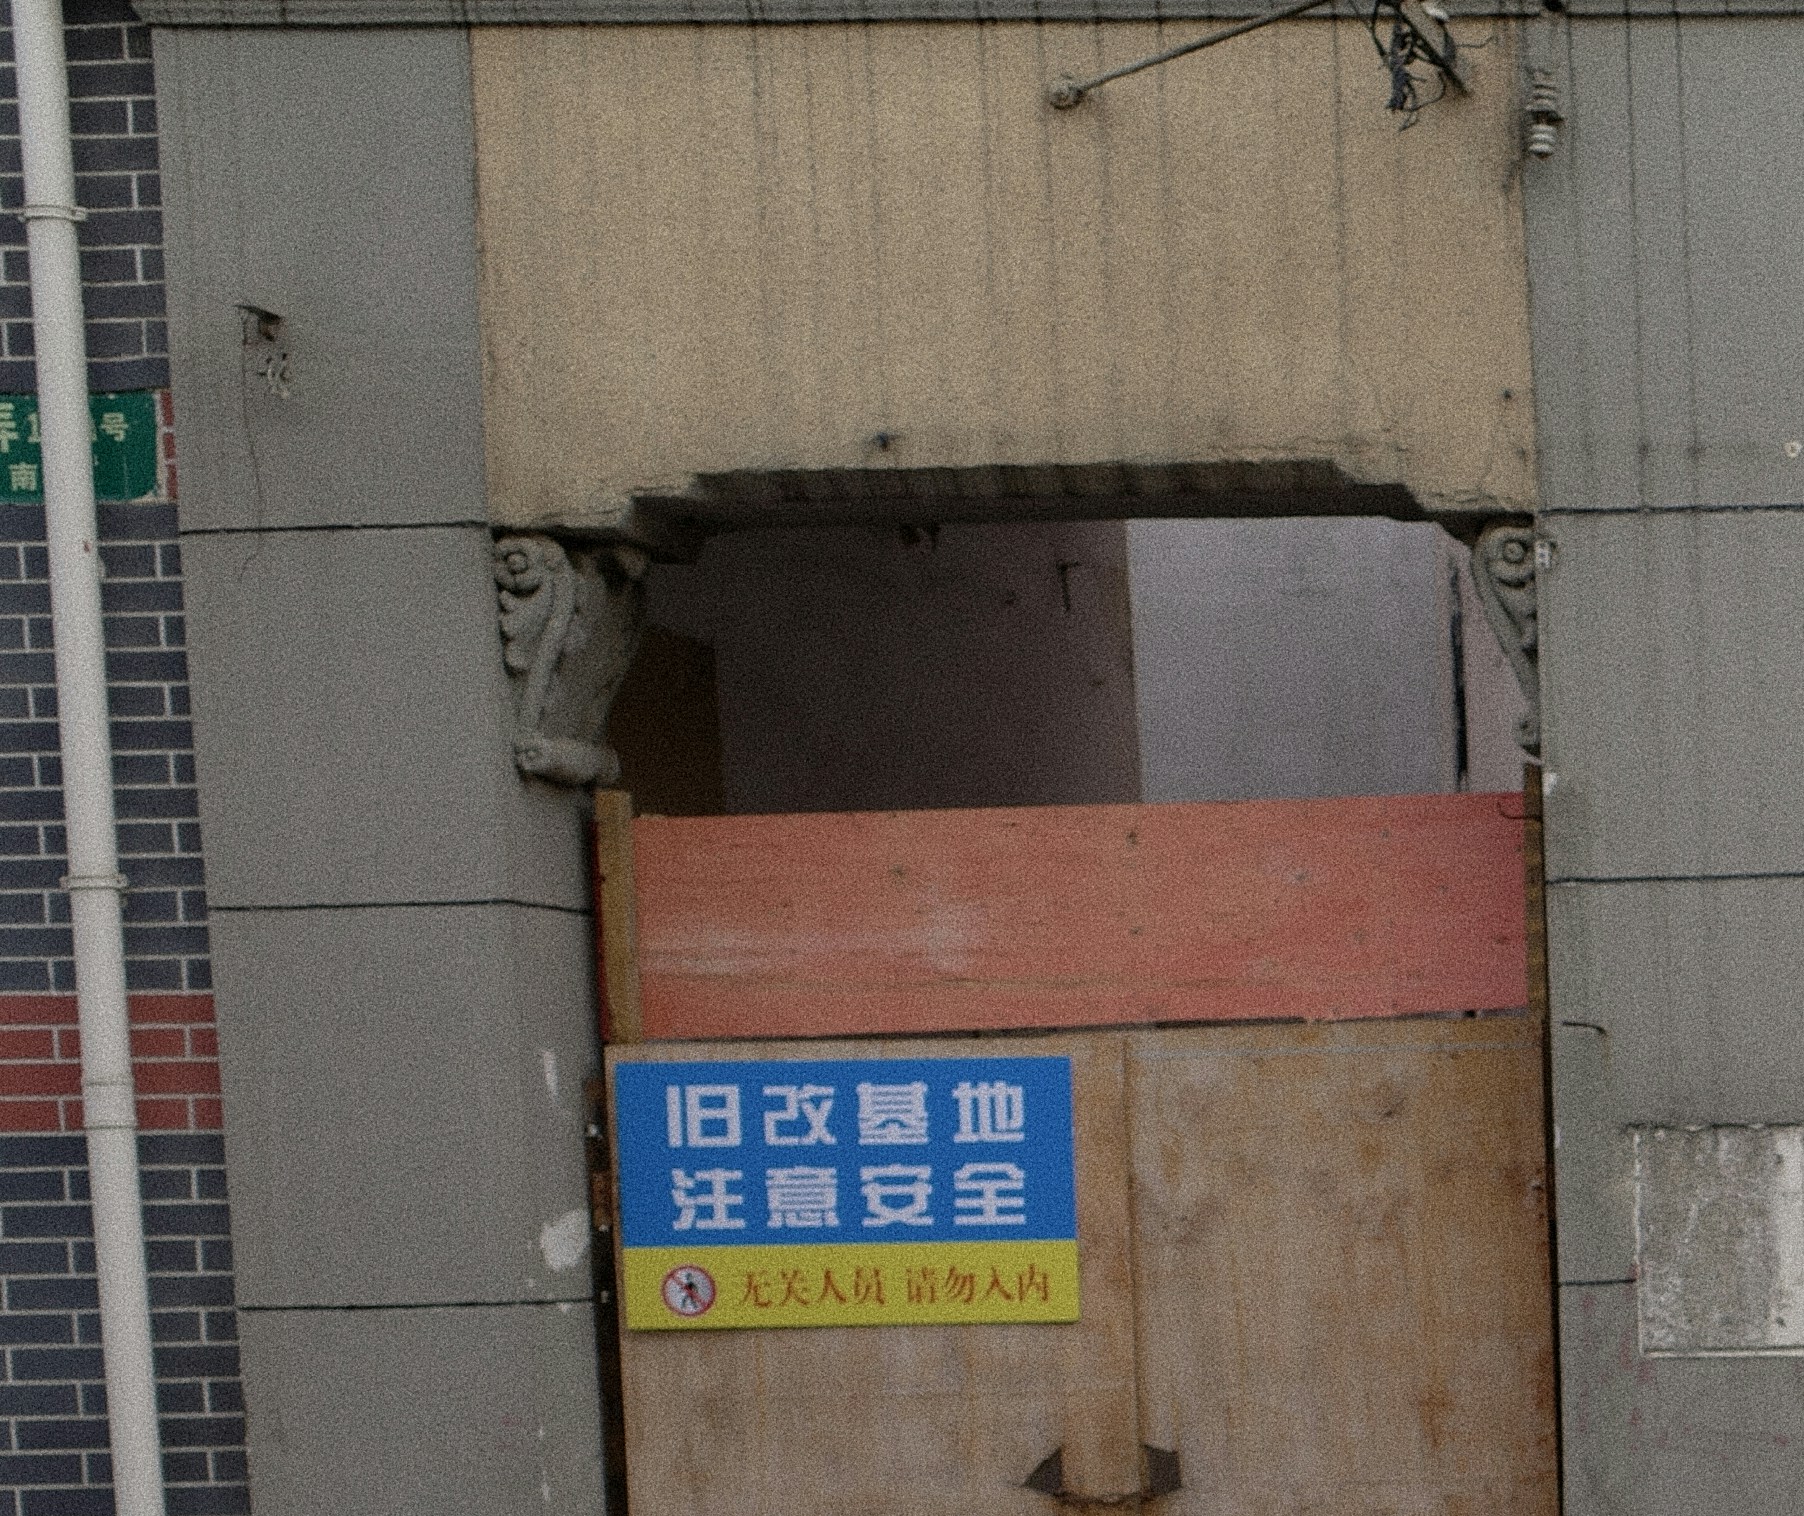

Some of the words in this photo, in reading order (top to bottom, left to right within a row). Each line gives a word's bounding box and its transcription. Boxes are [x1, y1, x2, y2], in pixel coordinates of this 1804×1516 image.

[666, 1081, 1025, 1147] 旧改基地
[672, 1162, 1027, 1230] 注意安全
[743, 1267, 886, 1309] 无关人员
[906, 1263, 1050, 1305] 请勿入内
